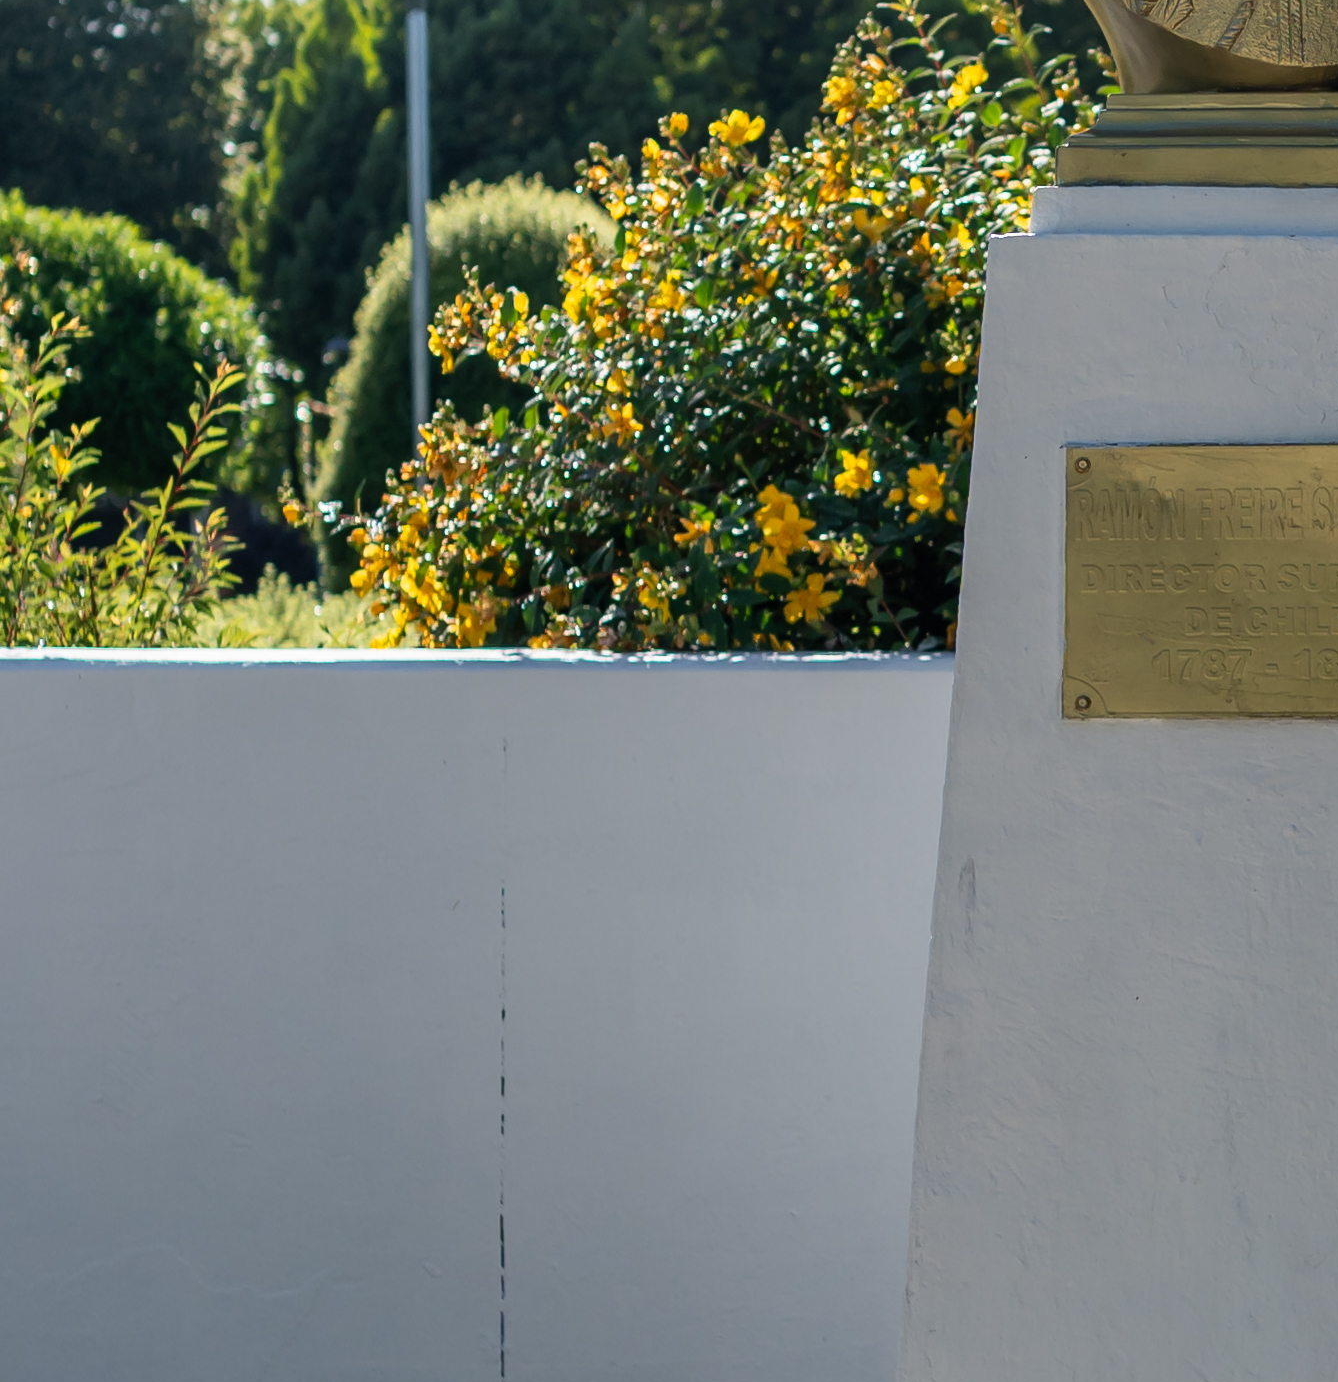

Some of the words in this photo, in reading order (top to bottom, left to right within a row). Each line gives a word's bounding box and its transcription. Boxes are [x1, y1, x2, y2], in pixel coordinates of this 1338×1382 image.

[1074, 476, 1186, 541] RAMÓN
[1195, 487, 1304, 541] FREIRE
[1081, 563, 1268, 594] DIRECTOR
[1185, 606, 1232, 637] DE
[1152, 648, 1252, 681] 1787
